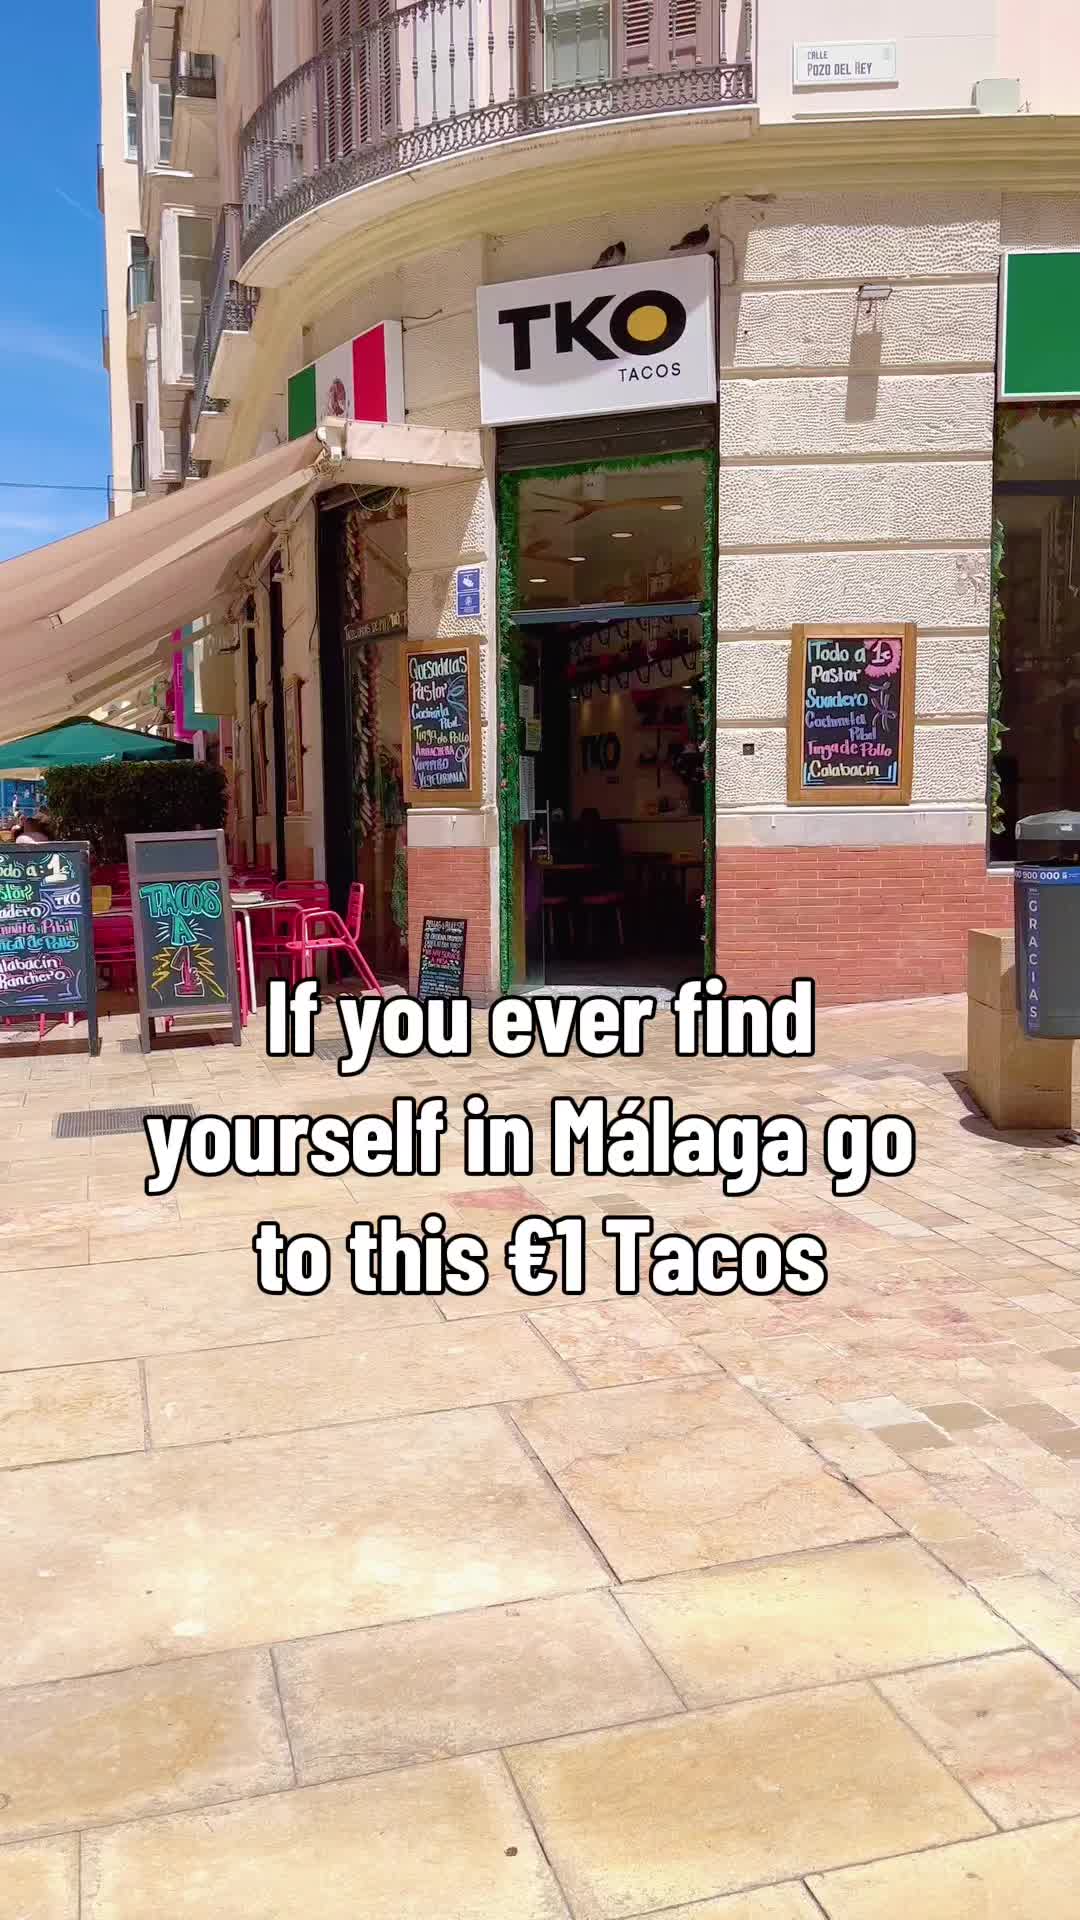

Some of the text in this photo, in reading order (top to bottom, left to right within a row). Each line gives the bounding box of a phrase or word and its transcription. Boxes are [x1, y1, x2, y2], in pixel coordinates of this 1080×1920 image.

[807, 51, 828, 60] CALLE
[807, 62, 872, 77] POZO DEL REY
[498, 289, 687, 371] TKO
[618, 362, 681, 383] TACOS
[55, 892, 80, 906] TKO
[139, 880, 223, 919] TACOS
[171, 915, 198, 946] A
[1028, 899, 1040, 1019] GRACIAS
